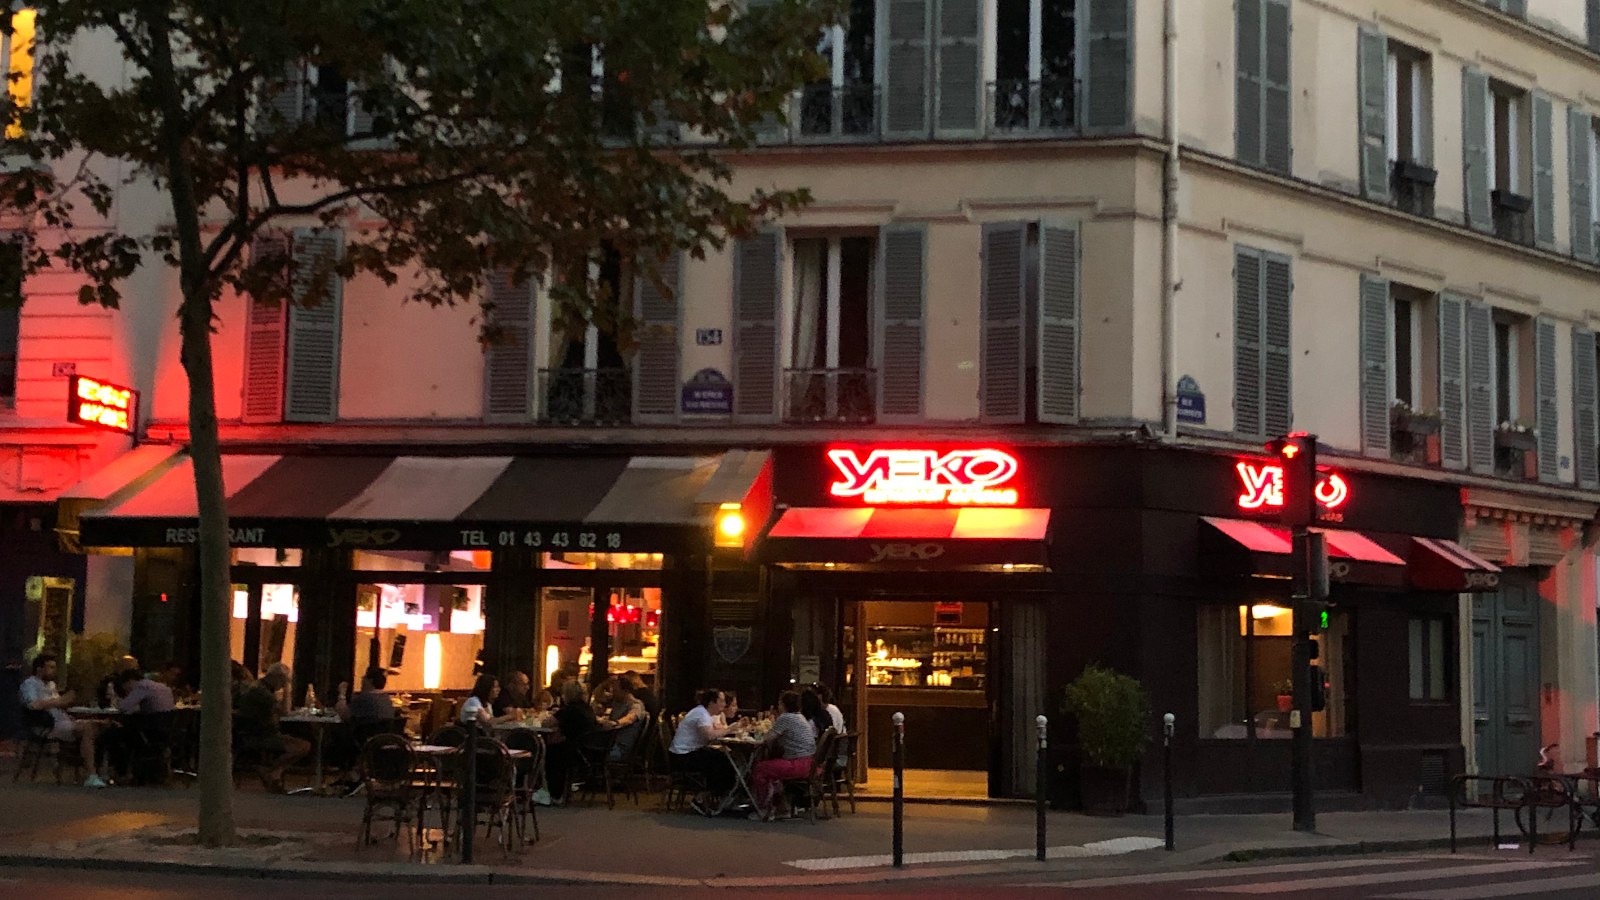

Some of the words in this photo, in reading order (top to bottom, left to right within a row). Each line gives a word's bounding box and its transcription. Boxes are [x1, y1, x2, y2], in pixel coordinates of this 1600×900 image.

[828, 448, 1018, 496] YEKO
[1236, 462, 1348, 508] YEO
[166, 527, 265, 544] RESRANT
[460, 530, 489, 546] TEL
[499, 531, 515, 545] 01
[524, 531, 541, 546] 43
[552, 532, 569, 547] 43
[579, 533, 597, 547] 82
[606, 533, 621, 548] 18
